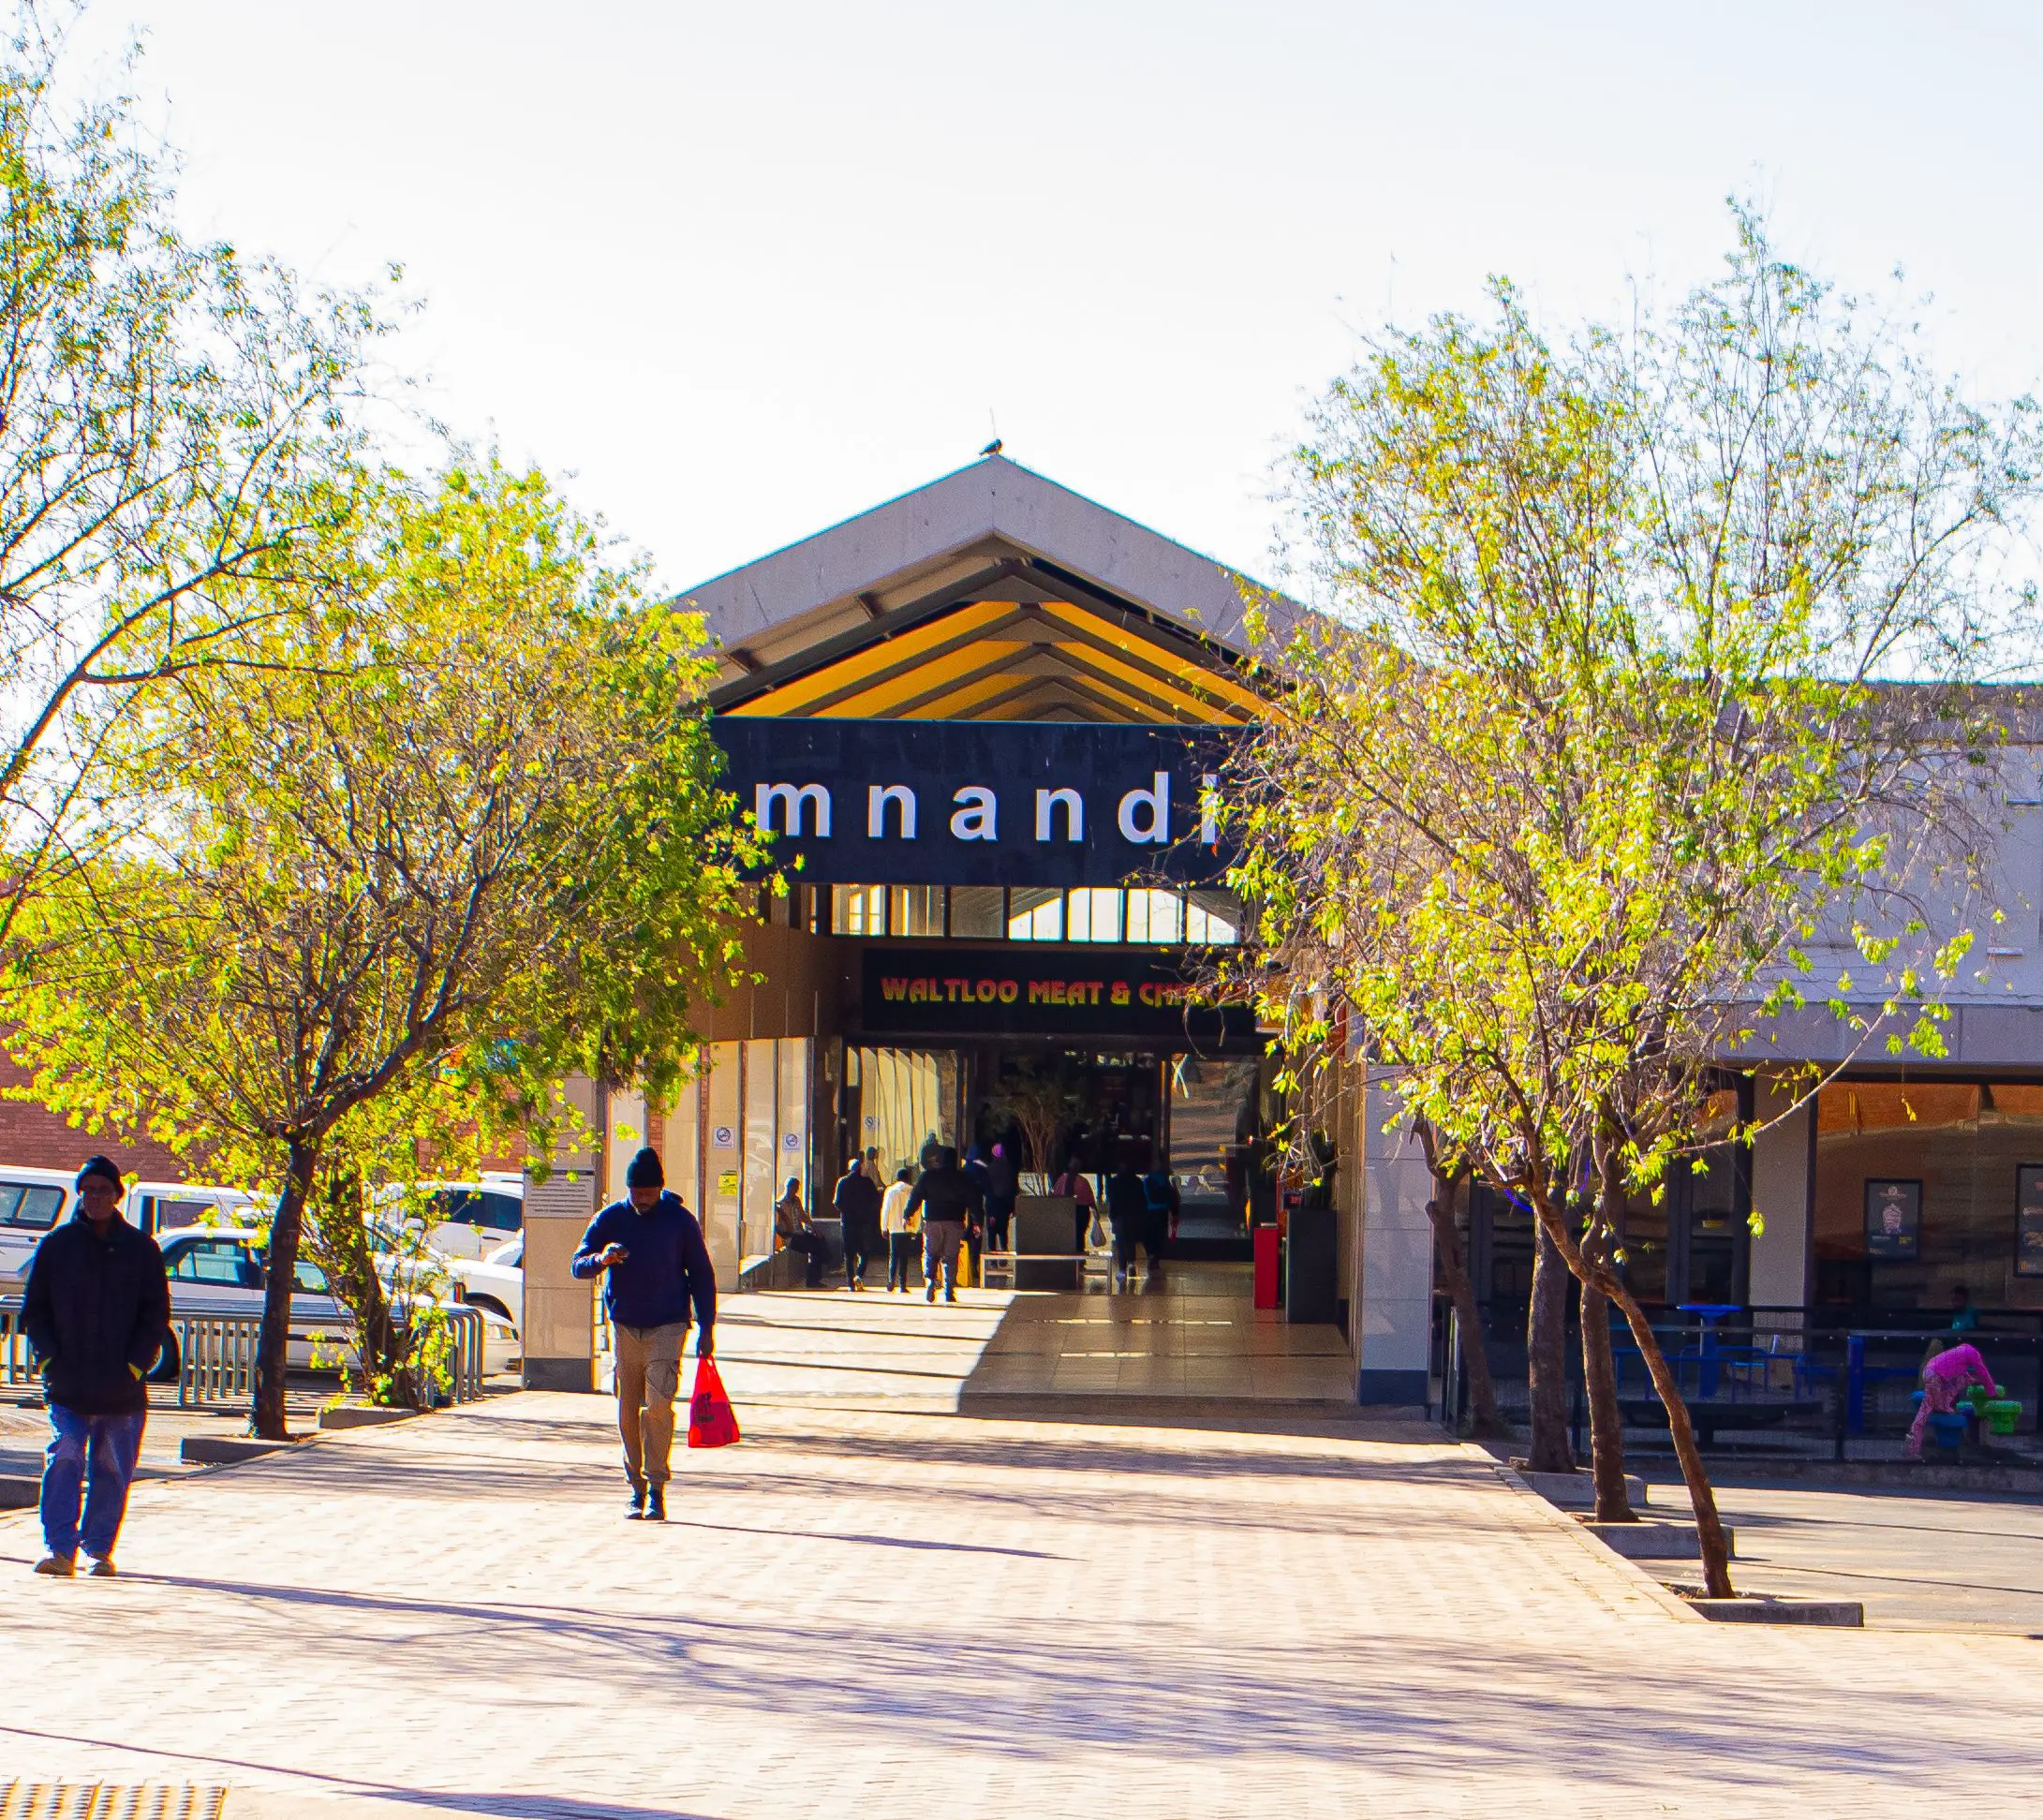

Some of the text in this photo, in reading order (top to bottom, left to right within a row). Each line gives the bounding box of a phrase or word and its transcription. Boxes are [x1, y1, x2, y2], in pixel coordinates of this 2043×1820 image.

[755, 771, 1218, 843] mnandi
[881, 977, 1019, 1003] WALTLOO
[1028, 980, 1103, 1006] MEAT
[1109, 982, 1131, 1005] &
